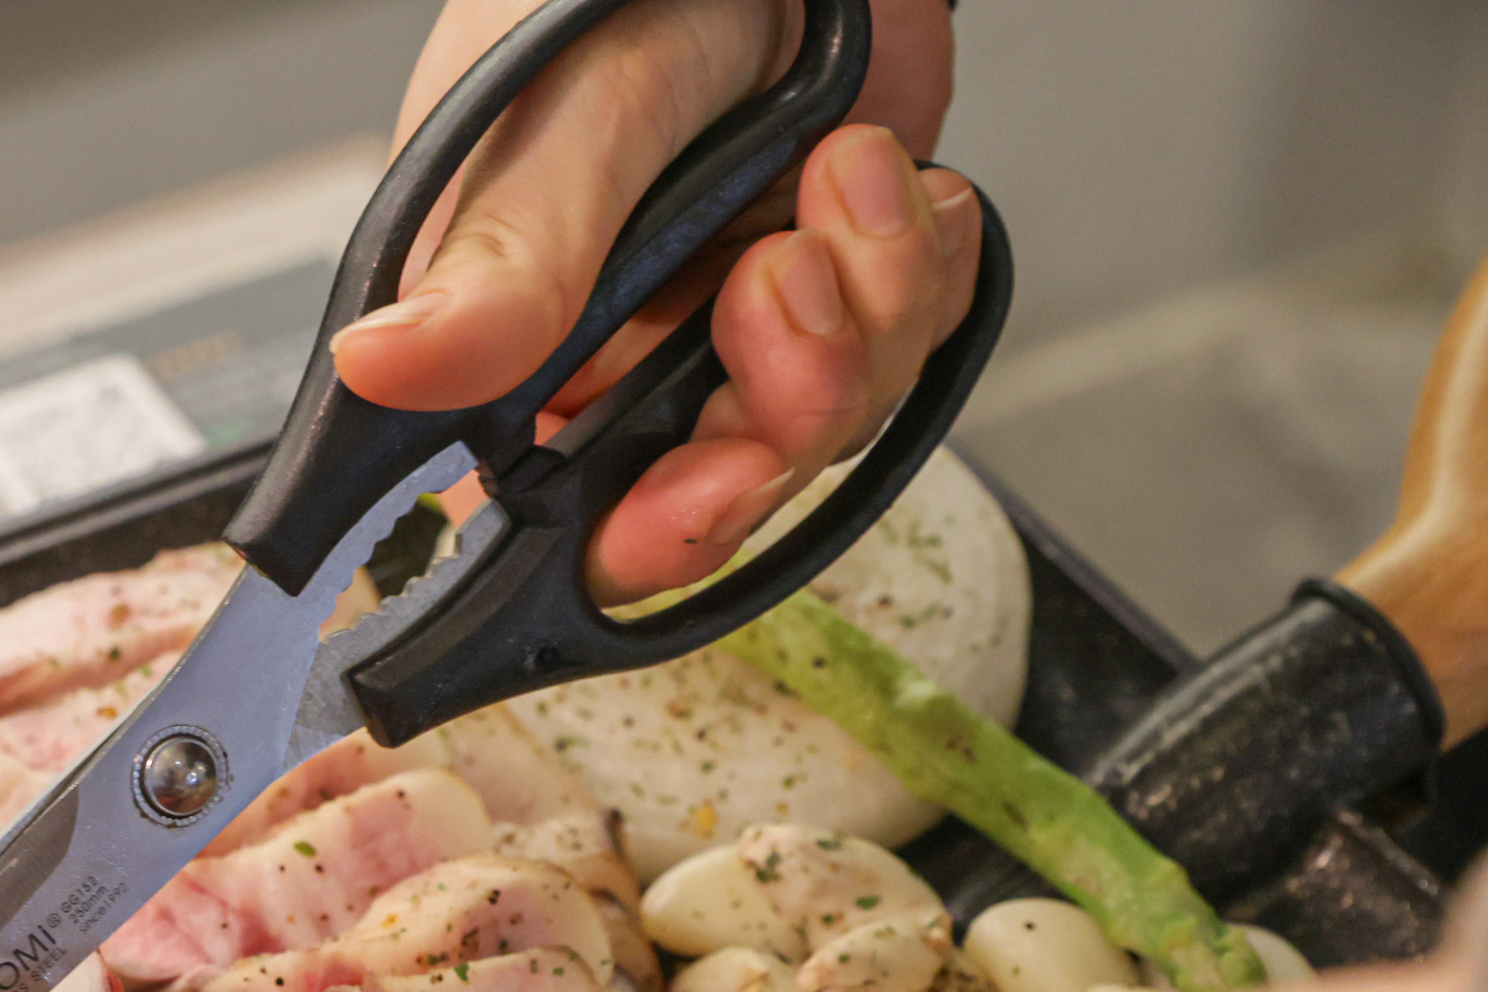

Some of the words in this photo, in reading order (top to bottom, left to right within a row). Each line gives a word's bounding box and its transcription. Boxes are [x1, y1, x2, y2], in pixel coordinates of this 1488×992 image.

[60, 875, 98, 914] GG152
[68, 885, 109, 925] 250mm
[30, 946, 68, 982] STEEL
